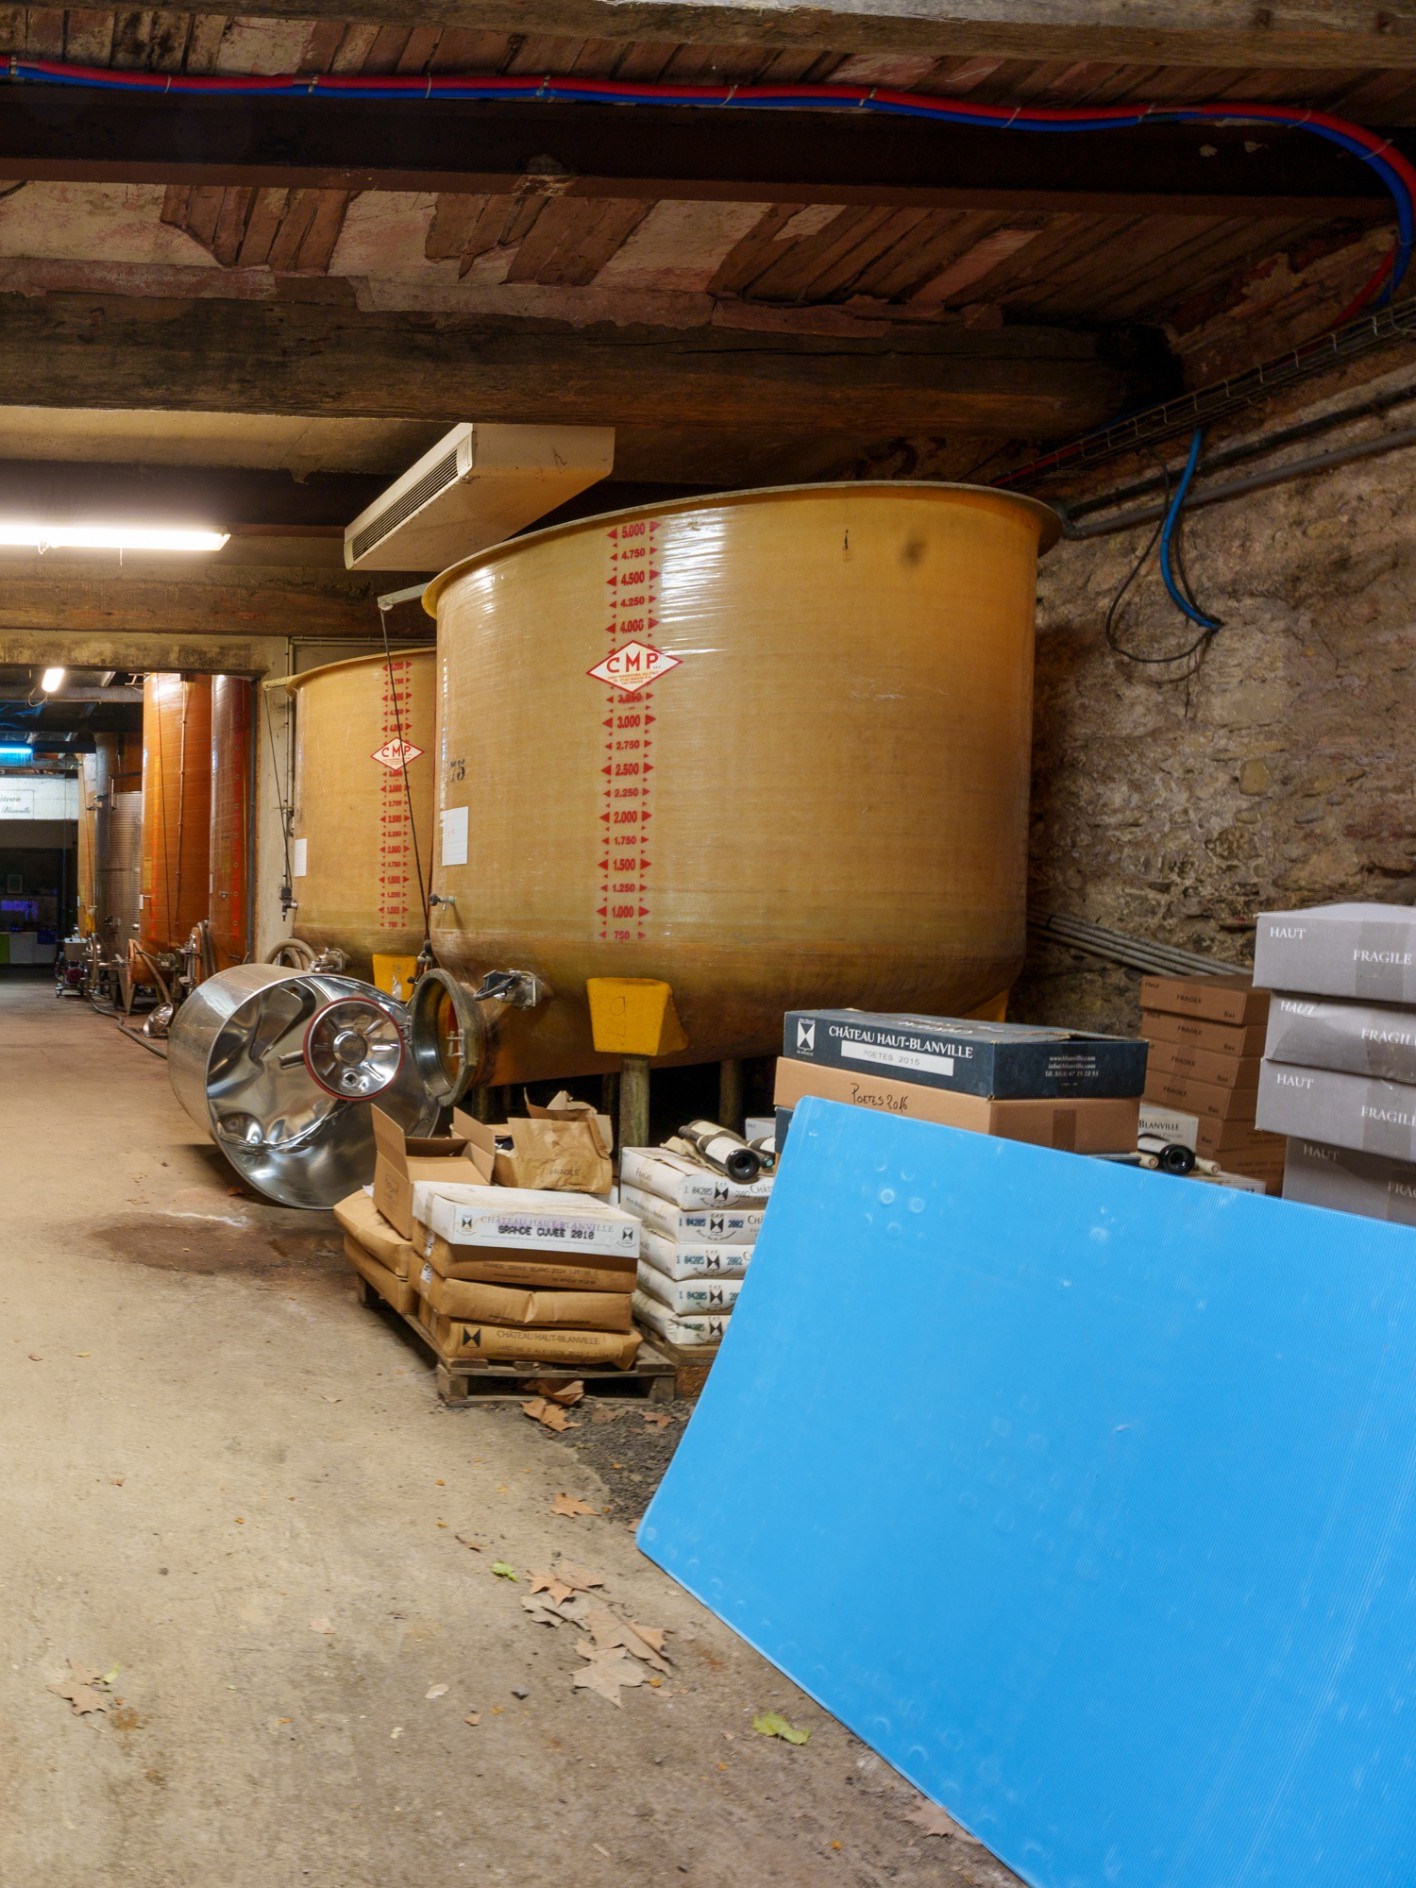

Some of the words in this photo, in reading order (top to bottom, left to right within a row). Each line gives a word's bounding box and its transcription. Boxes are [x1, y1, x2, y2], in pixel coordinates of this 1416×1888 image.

[622, 523, 645, 539] 5.000
[621, 548, 645, 560] 4.750
[621, 571, 645, 586] 4.500
[620, 596, 644, 608] 4.250
[620, 619, 644, 634] 4.000
[606, 651, 659, 673] CMP
[617, 714, 641, 729] 3.000
[381, 745, 411, 758] CMP
[616, 740, 640, 750] 2.750
[615, 763, 639, 776] 2.500
[614, 788, 639, 797] 2.250
[614, 811, 637, 823] 2.000
[614, 836, 637, 845] 1.750
[613, 858, 636, 871] 1.500
[613, 884, 635, 893] 1.250
[612, 905, 634, 918] 1.000
[614, 931, 630, 939] 750
[1269, 927, 1306, 940] HAUT
[1352, 949, 1412, 965] FRAGILE
[1280, 1001, 1317, 1016] HAUT
[828, 1025, 875, 1043] CHÂTEAU
[877, 1032, 973, 1059] HAUT-BLANVILLE
[1276, 1073, 1314, 1089] HAUT
[1303, 1144, 1340, 1161] HAUT
